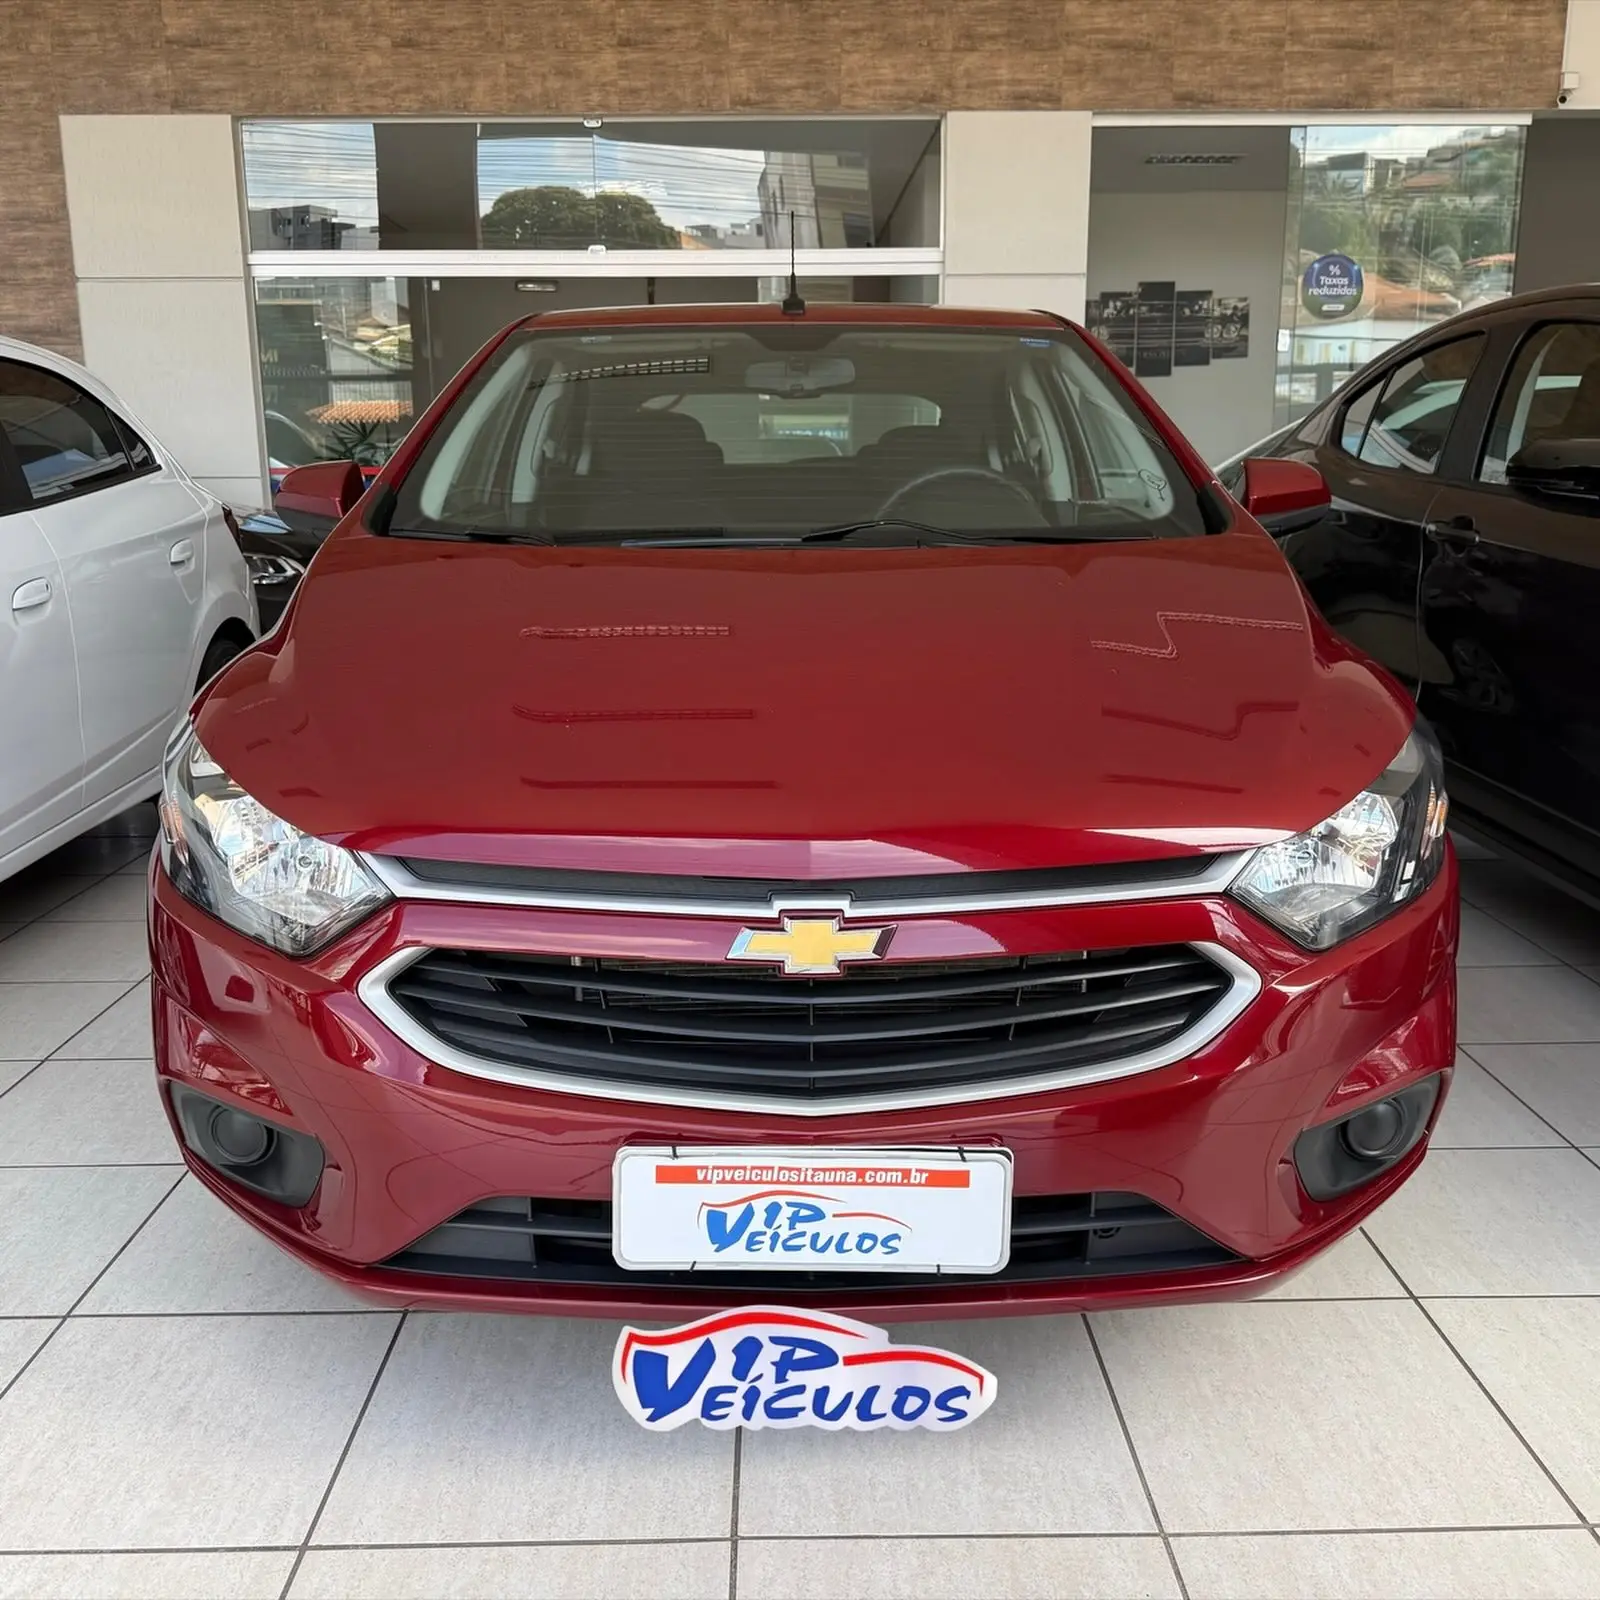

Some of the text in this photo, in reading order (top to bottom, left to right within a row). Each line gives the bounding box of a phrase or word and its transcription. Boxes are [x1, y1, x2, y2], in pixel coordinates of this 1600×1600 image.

[1320, 276, 1349, 286] Taxas
[1308, 284, 1357, 296] reduzidas
[696, 1165, 928, 1185] vipveiculositauna.com.br
[706, 1200, 826, 1252] VIP
